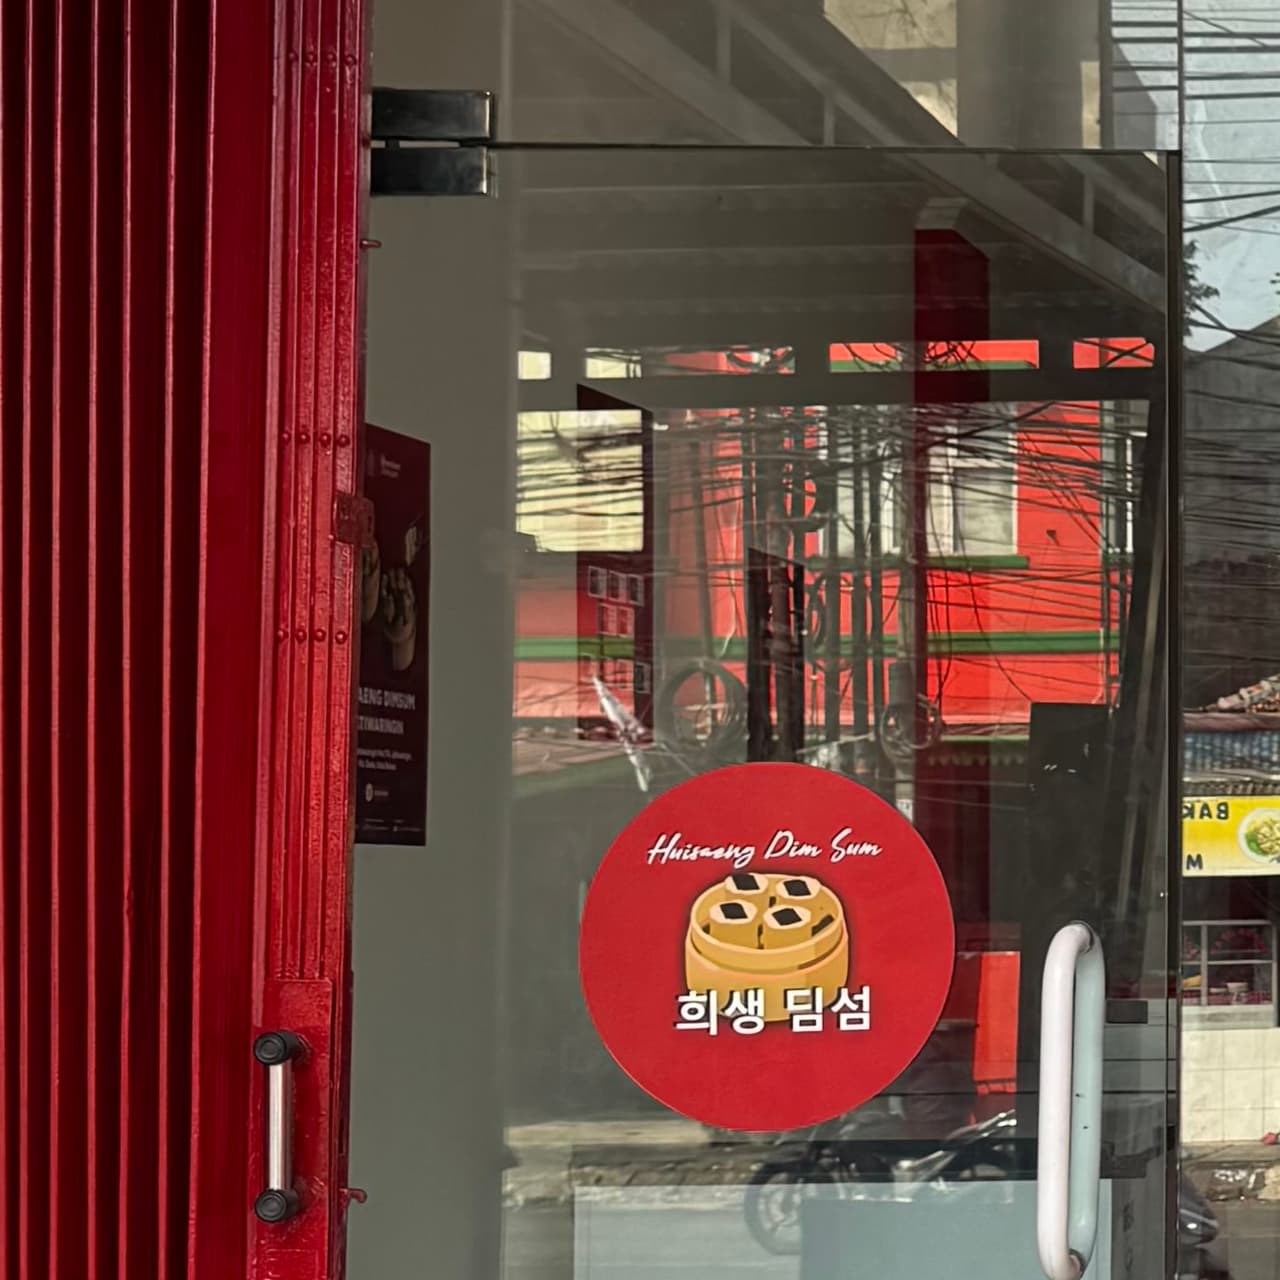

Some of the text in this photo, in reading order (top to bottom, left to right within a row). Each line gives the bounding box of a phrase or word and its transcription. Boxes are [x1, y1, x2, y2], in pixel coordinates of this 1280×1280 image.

[764, 830, 822, 859] Dim
[830, 828, 883, 863] Sum
[675, 986, 871, 1035] 희생 딤섬
